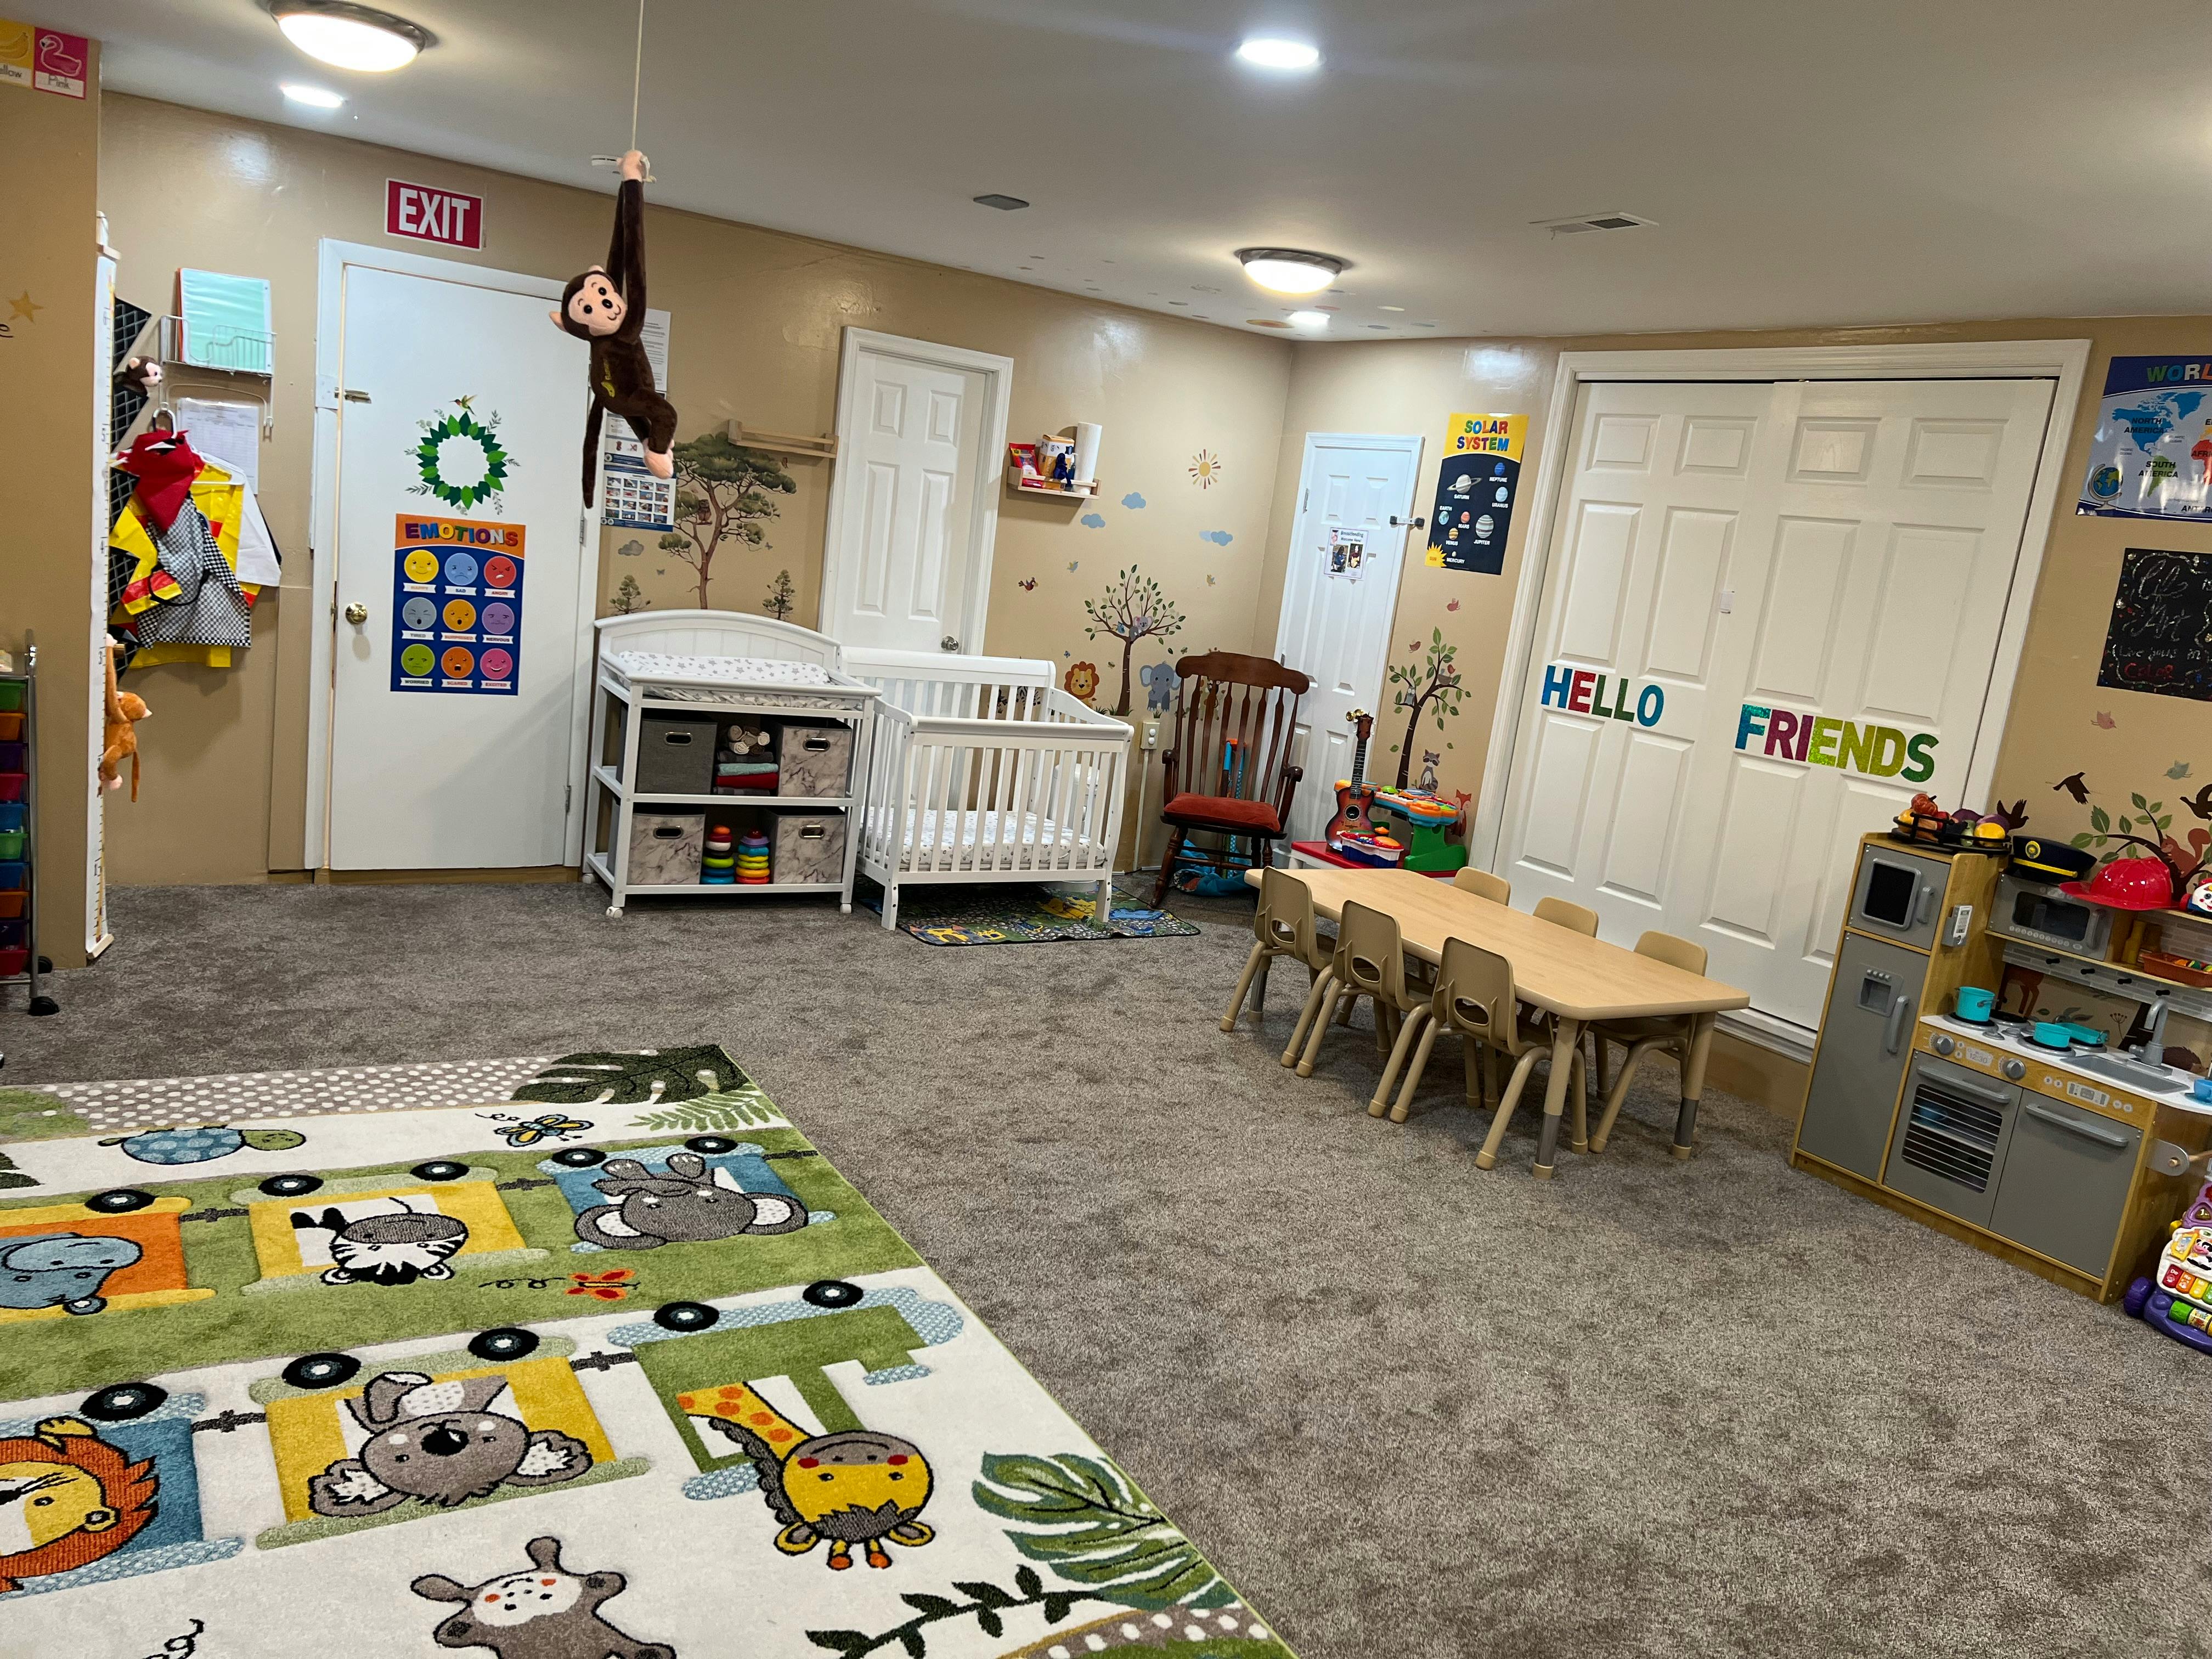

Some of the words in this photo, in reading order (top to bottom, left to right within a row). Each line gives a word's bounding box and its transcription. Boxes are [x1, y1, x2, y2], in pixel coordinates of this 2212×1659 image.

[48, 75, 70, 89] Pink
[399, 187, 470, 242] EXIT
[1464, 420, 1509, 435] SOLAR
[1457, 436, 1510, 452] SYSTEM
[405, 523, 518, 547] EMOTIONS
[1541, 665, 1664, 727] HELLO
[1735, 704, 1939, 783] FRIENDS
[1970, 1053, 1988, 1064] 12:30
